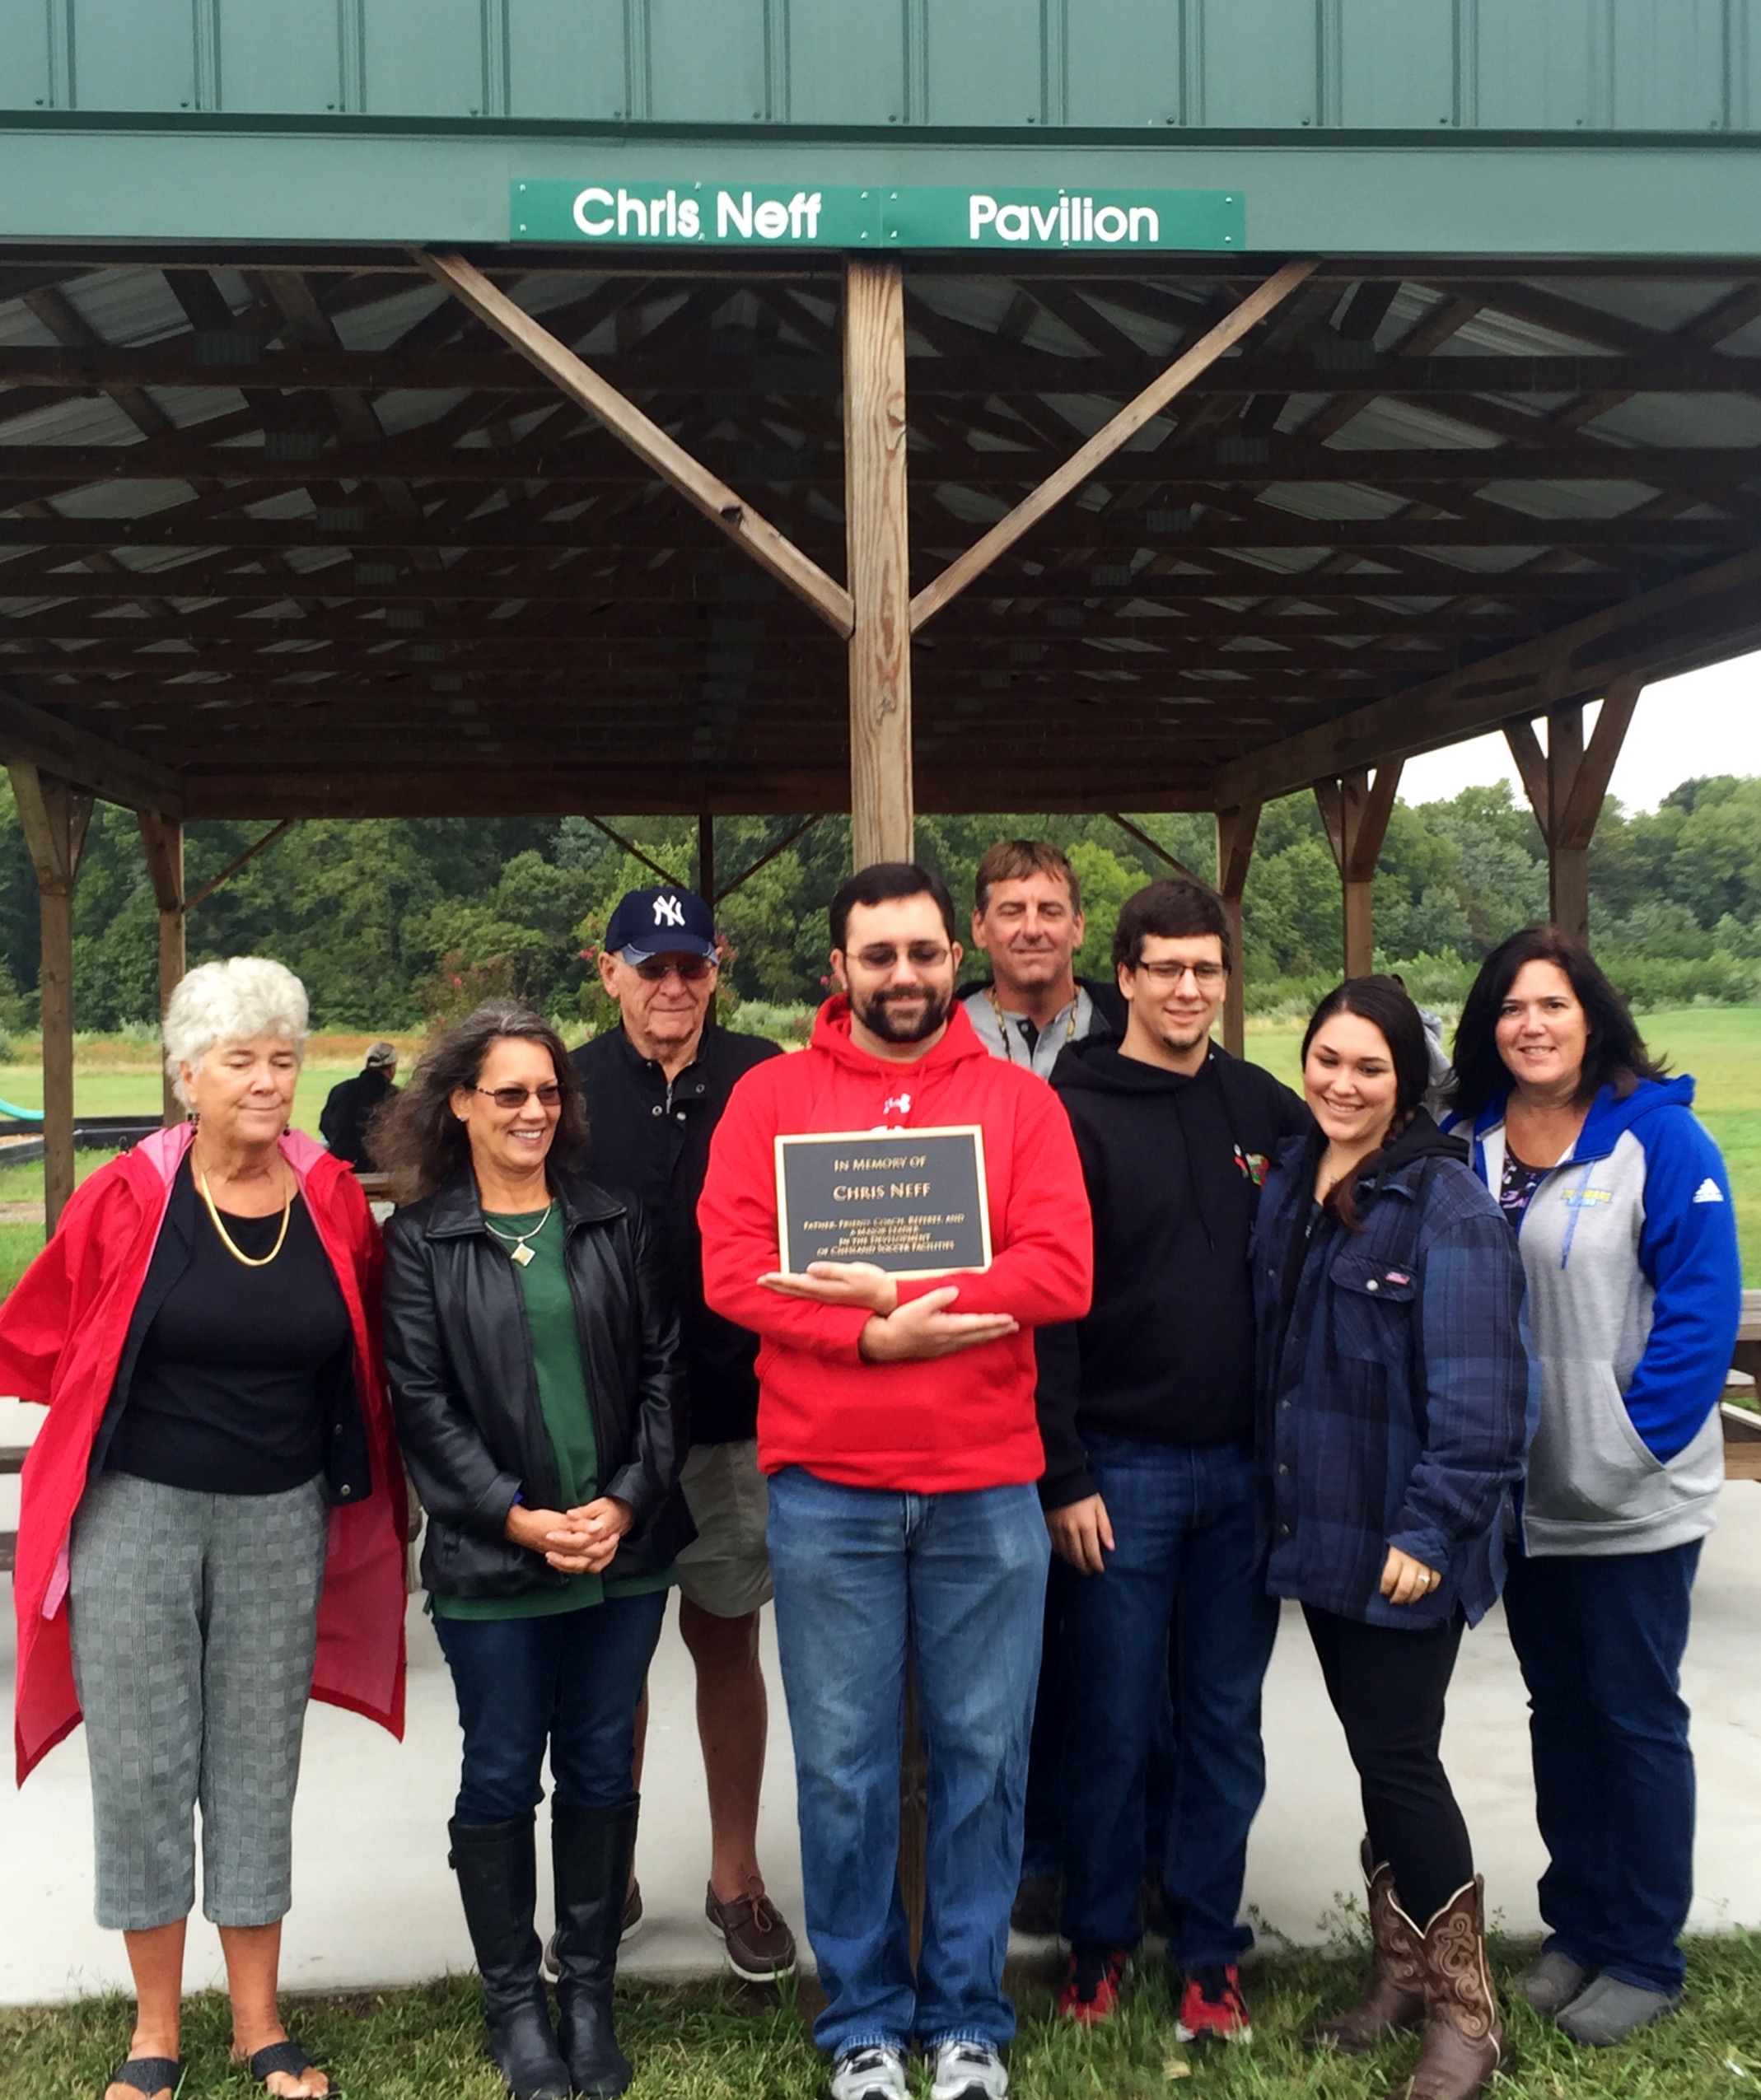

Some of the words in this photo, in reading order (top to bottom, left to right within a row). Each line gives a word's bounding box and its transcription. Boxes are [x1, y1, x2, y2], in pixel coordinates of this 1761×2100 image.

[573, 187, 700, 237] Chris
[717, 191, 821, 239] Neff
[969, 194, 1159, 242] Pavilion
[652, 894, 685, 926] NY
